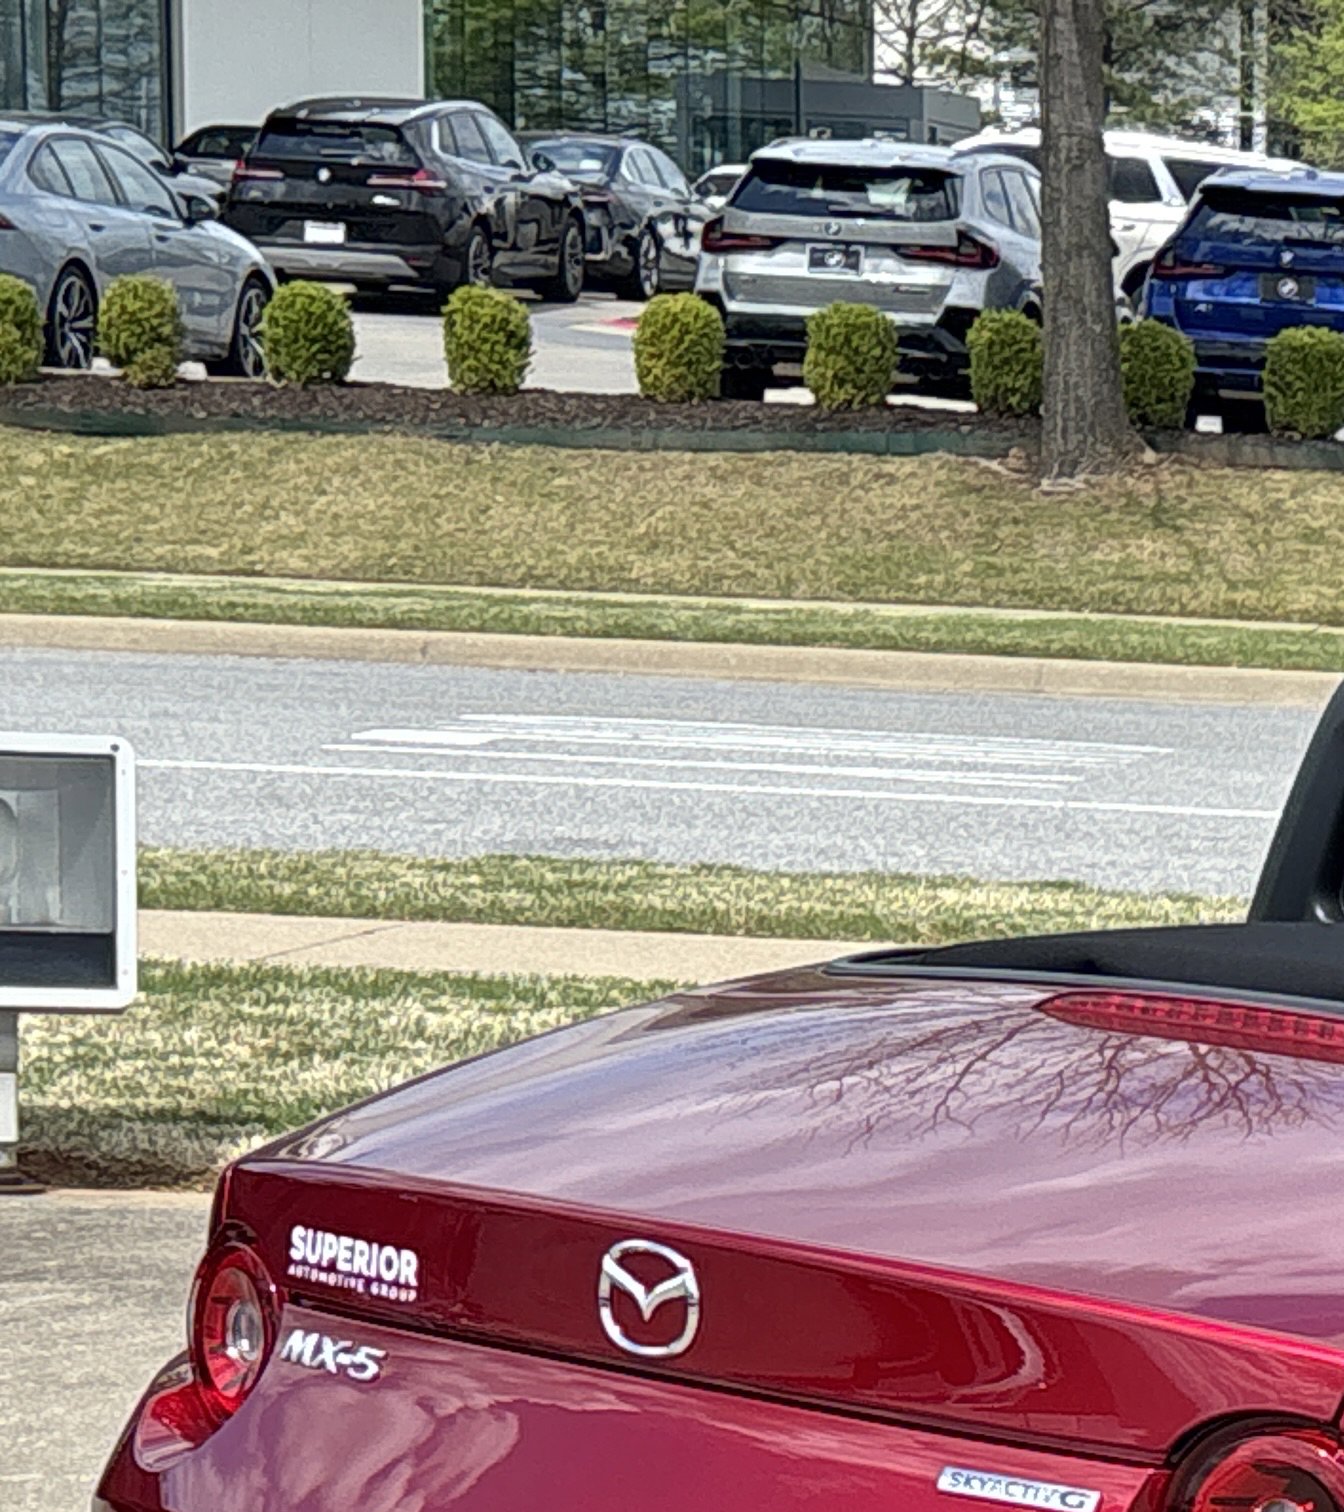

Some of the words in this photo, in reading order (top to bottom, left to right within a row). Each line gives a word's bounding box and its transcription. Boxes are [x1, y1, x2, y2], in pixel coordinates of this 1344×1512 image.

[287, 1263, 366, 1294] AUTOMOTIVE
[289, 1224, 419, 1287] SUPERIOR
[280, 1328, 388, 1382] MX-5
